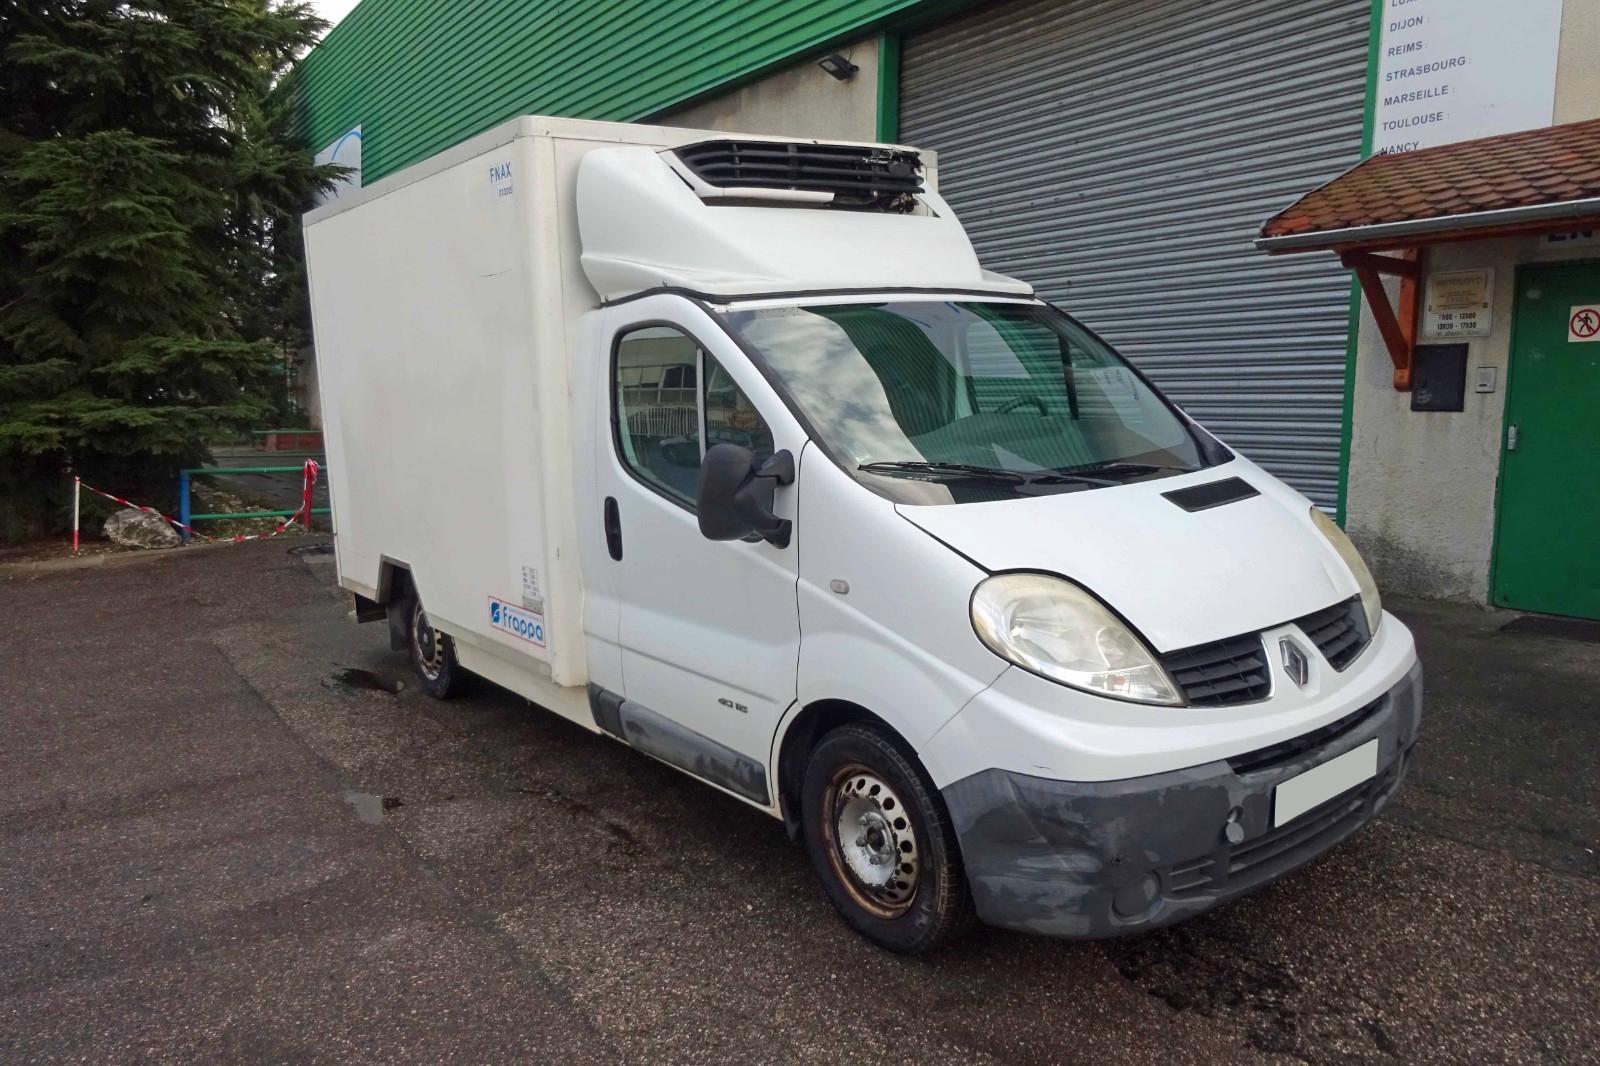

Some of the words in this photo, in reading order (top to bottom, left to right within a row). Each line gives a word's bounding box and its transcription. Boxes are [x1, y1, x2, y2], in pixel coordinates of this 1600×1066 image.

[1389, 15, 1424, 32] DIJON
[1387, 41, 1423, 57] REIMS
[1385, 56, 1466, 82] STRASBOURG
[1383, 85, 1449, 107] MARSEILLE
[1382, 111, 1444, 131] TOULOUSE
[1380, 140, 1420, 155] NANCY
[489, 161, 512, 184] FNAX
[503, 606, 544, 642] frappa
